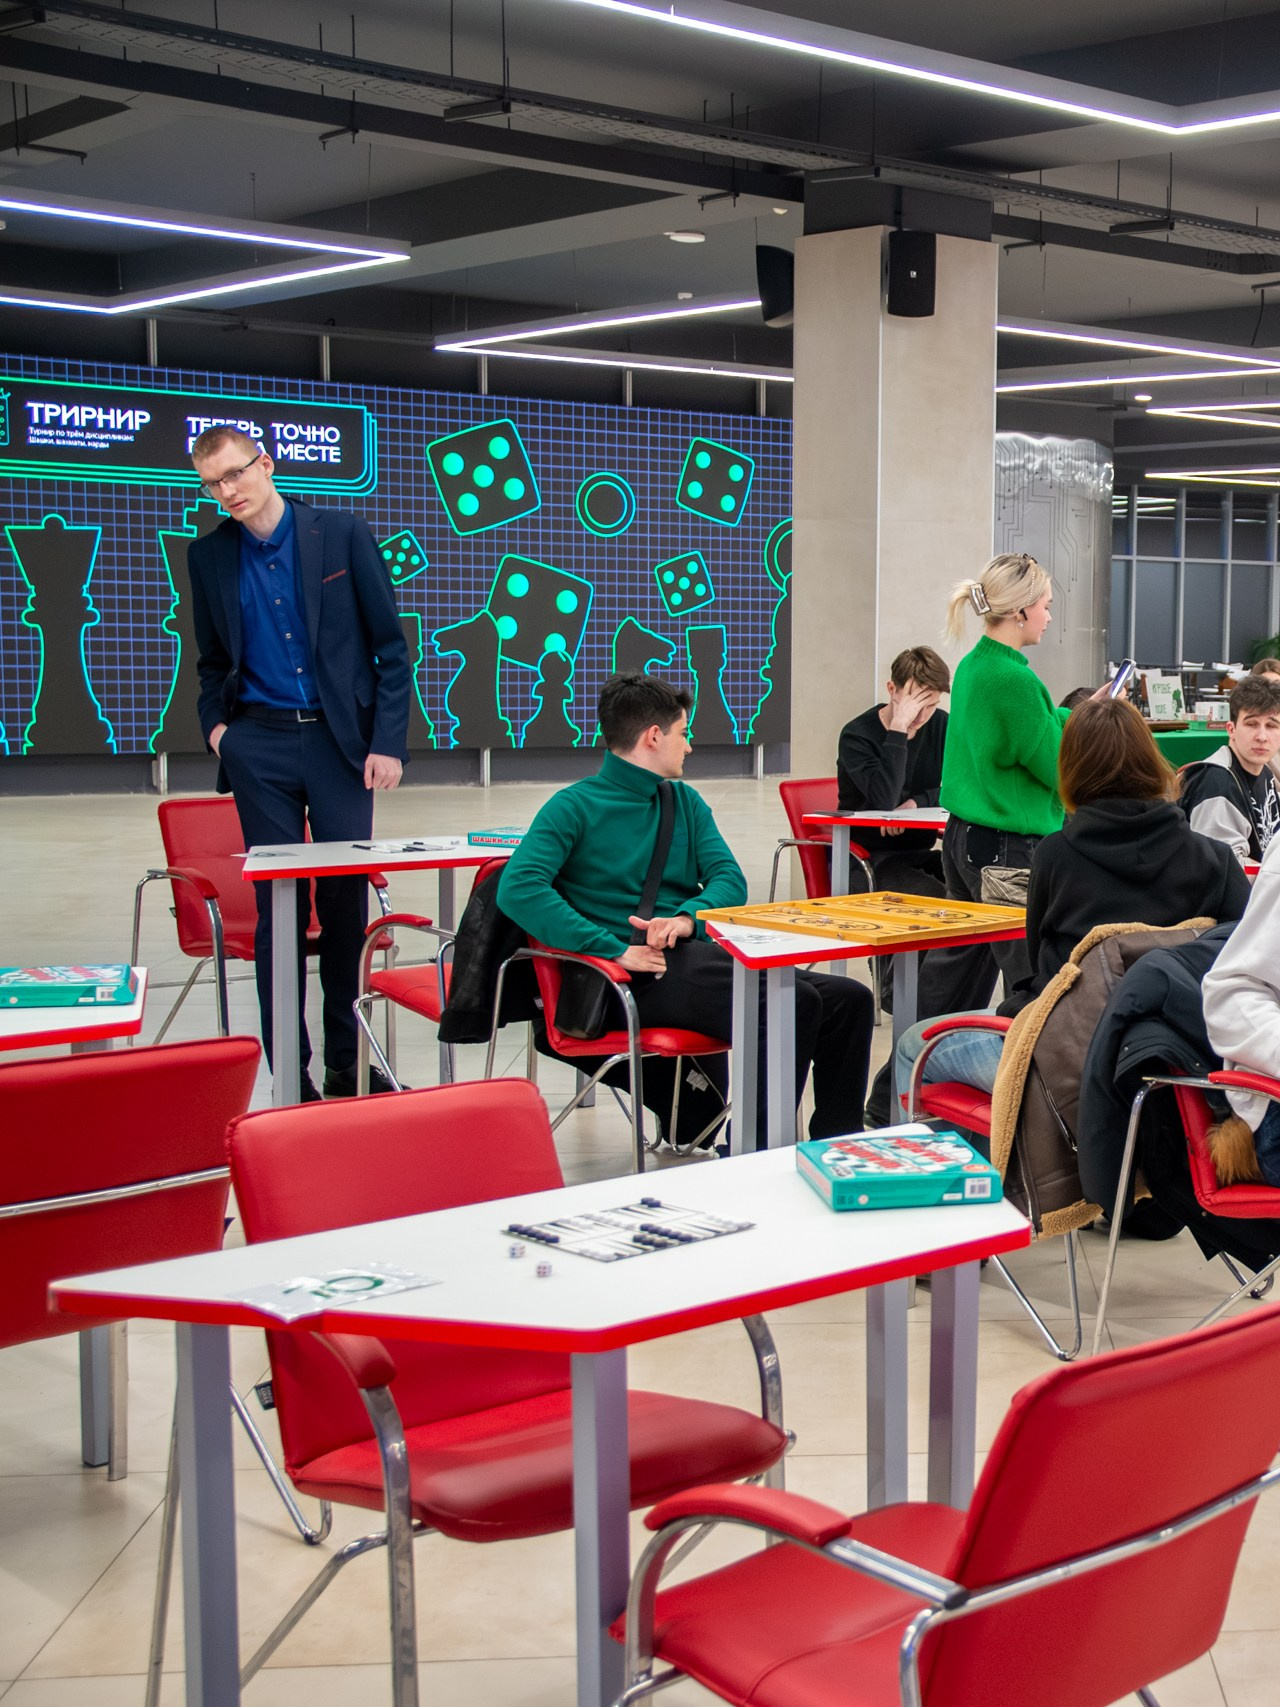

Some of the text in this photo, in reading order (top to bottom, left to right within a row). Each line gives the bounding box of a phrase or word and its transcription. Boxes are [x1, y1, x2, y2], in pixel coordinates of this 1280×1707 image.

[26, 401, 151, 431] ТРИРНИР
[29, 426, 54, 437] Турнир
[186, 416, 341, 443] ТЕРЬ ТОЧНО
[276, 442, 342, 463] МЕСТЕ
[472, 836, 502, 844] ШАШКИ
